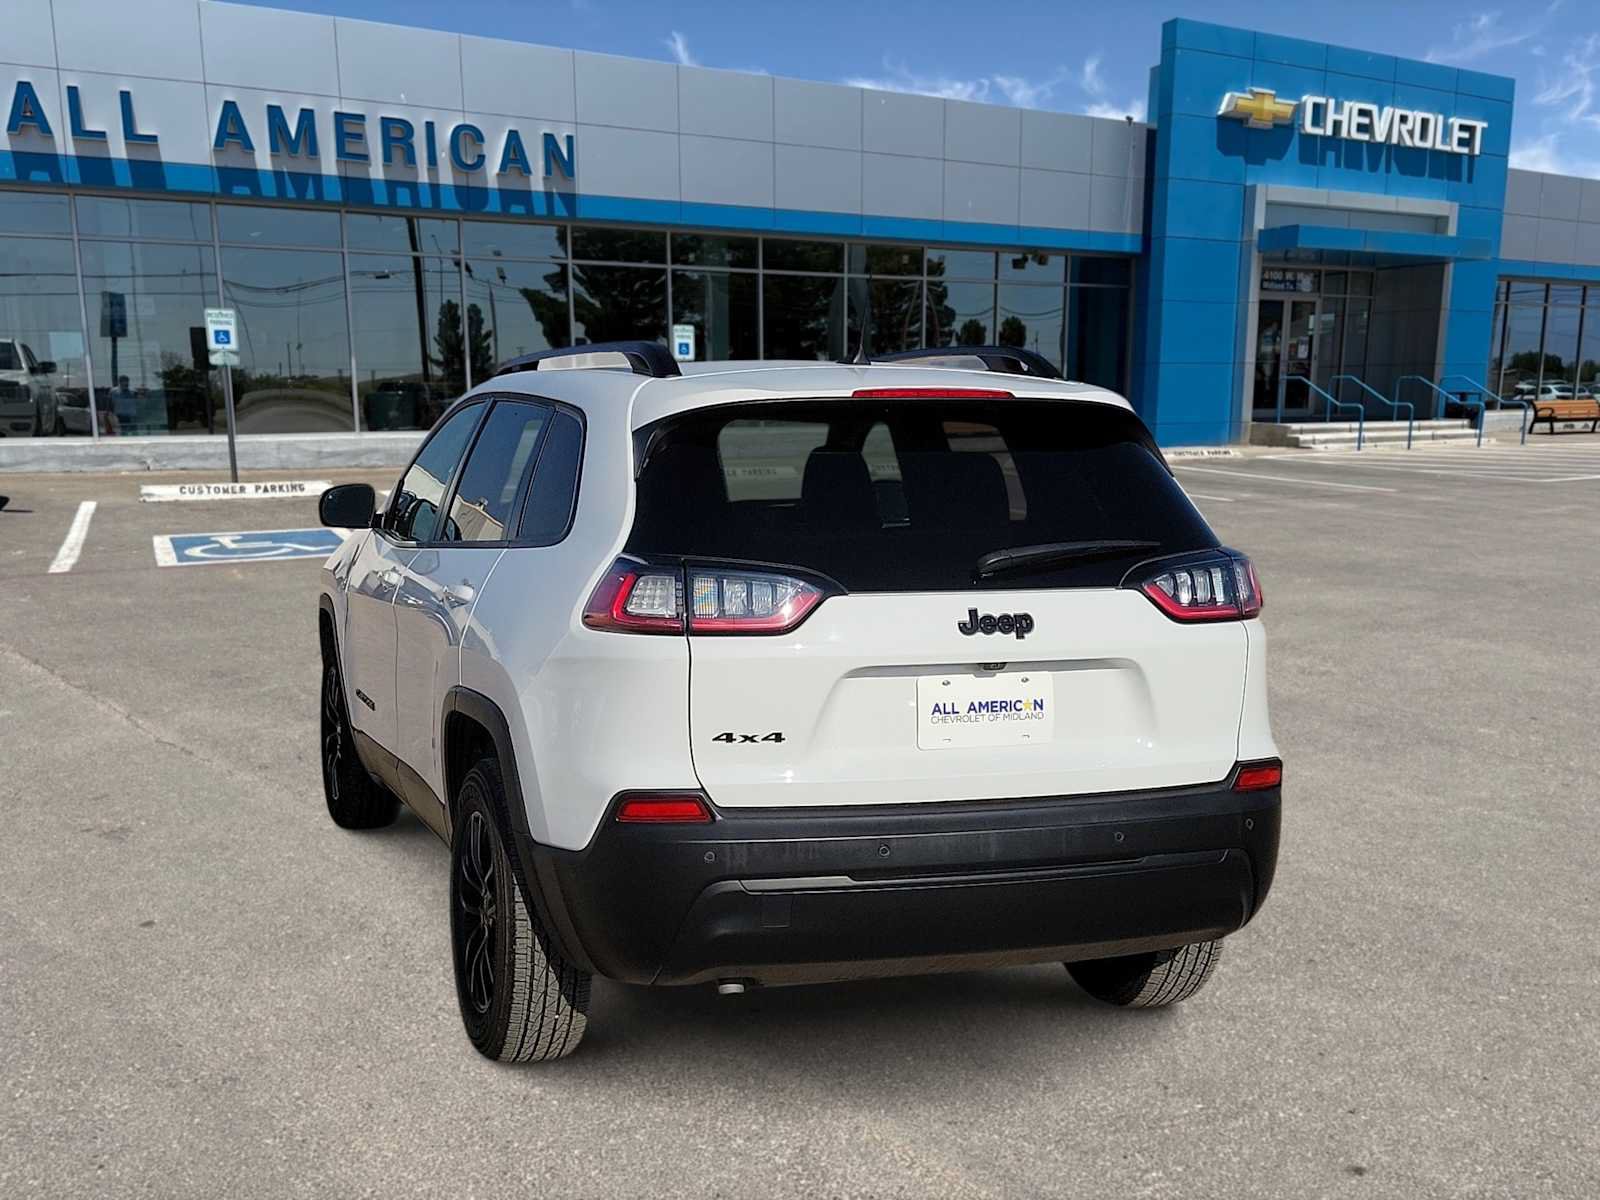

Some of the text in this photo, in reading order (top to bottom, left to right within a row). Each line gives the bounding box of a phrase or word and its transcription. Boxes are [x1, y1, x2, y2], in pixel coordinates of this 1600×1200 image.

[6, 80, 576, 179] ALL AMERICAN
[1301, 94, 1489, 156] CHEVROLET
[179, 483, 306, 495] CUSTOMER PARKING
[957, 607, 1034, 639] Jeep
[931, 698, 1044, 716] ALL AMERICN
[931, 711, 1044, 725] CHEVROLET OF MIDLAND
[711, 732, 786, 743] 4x4
